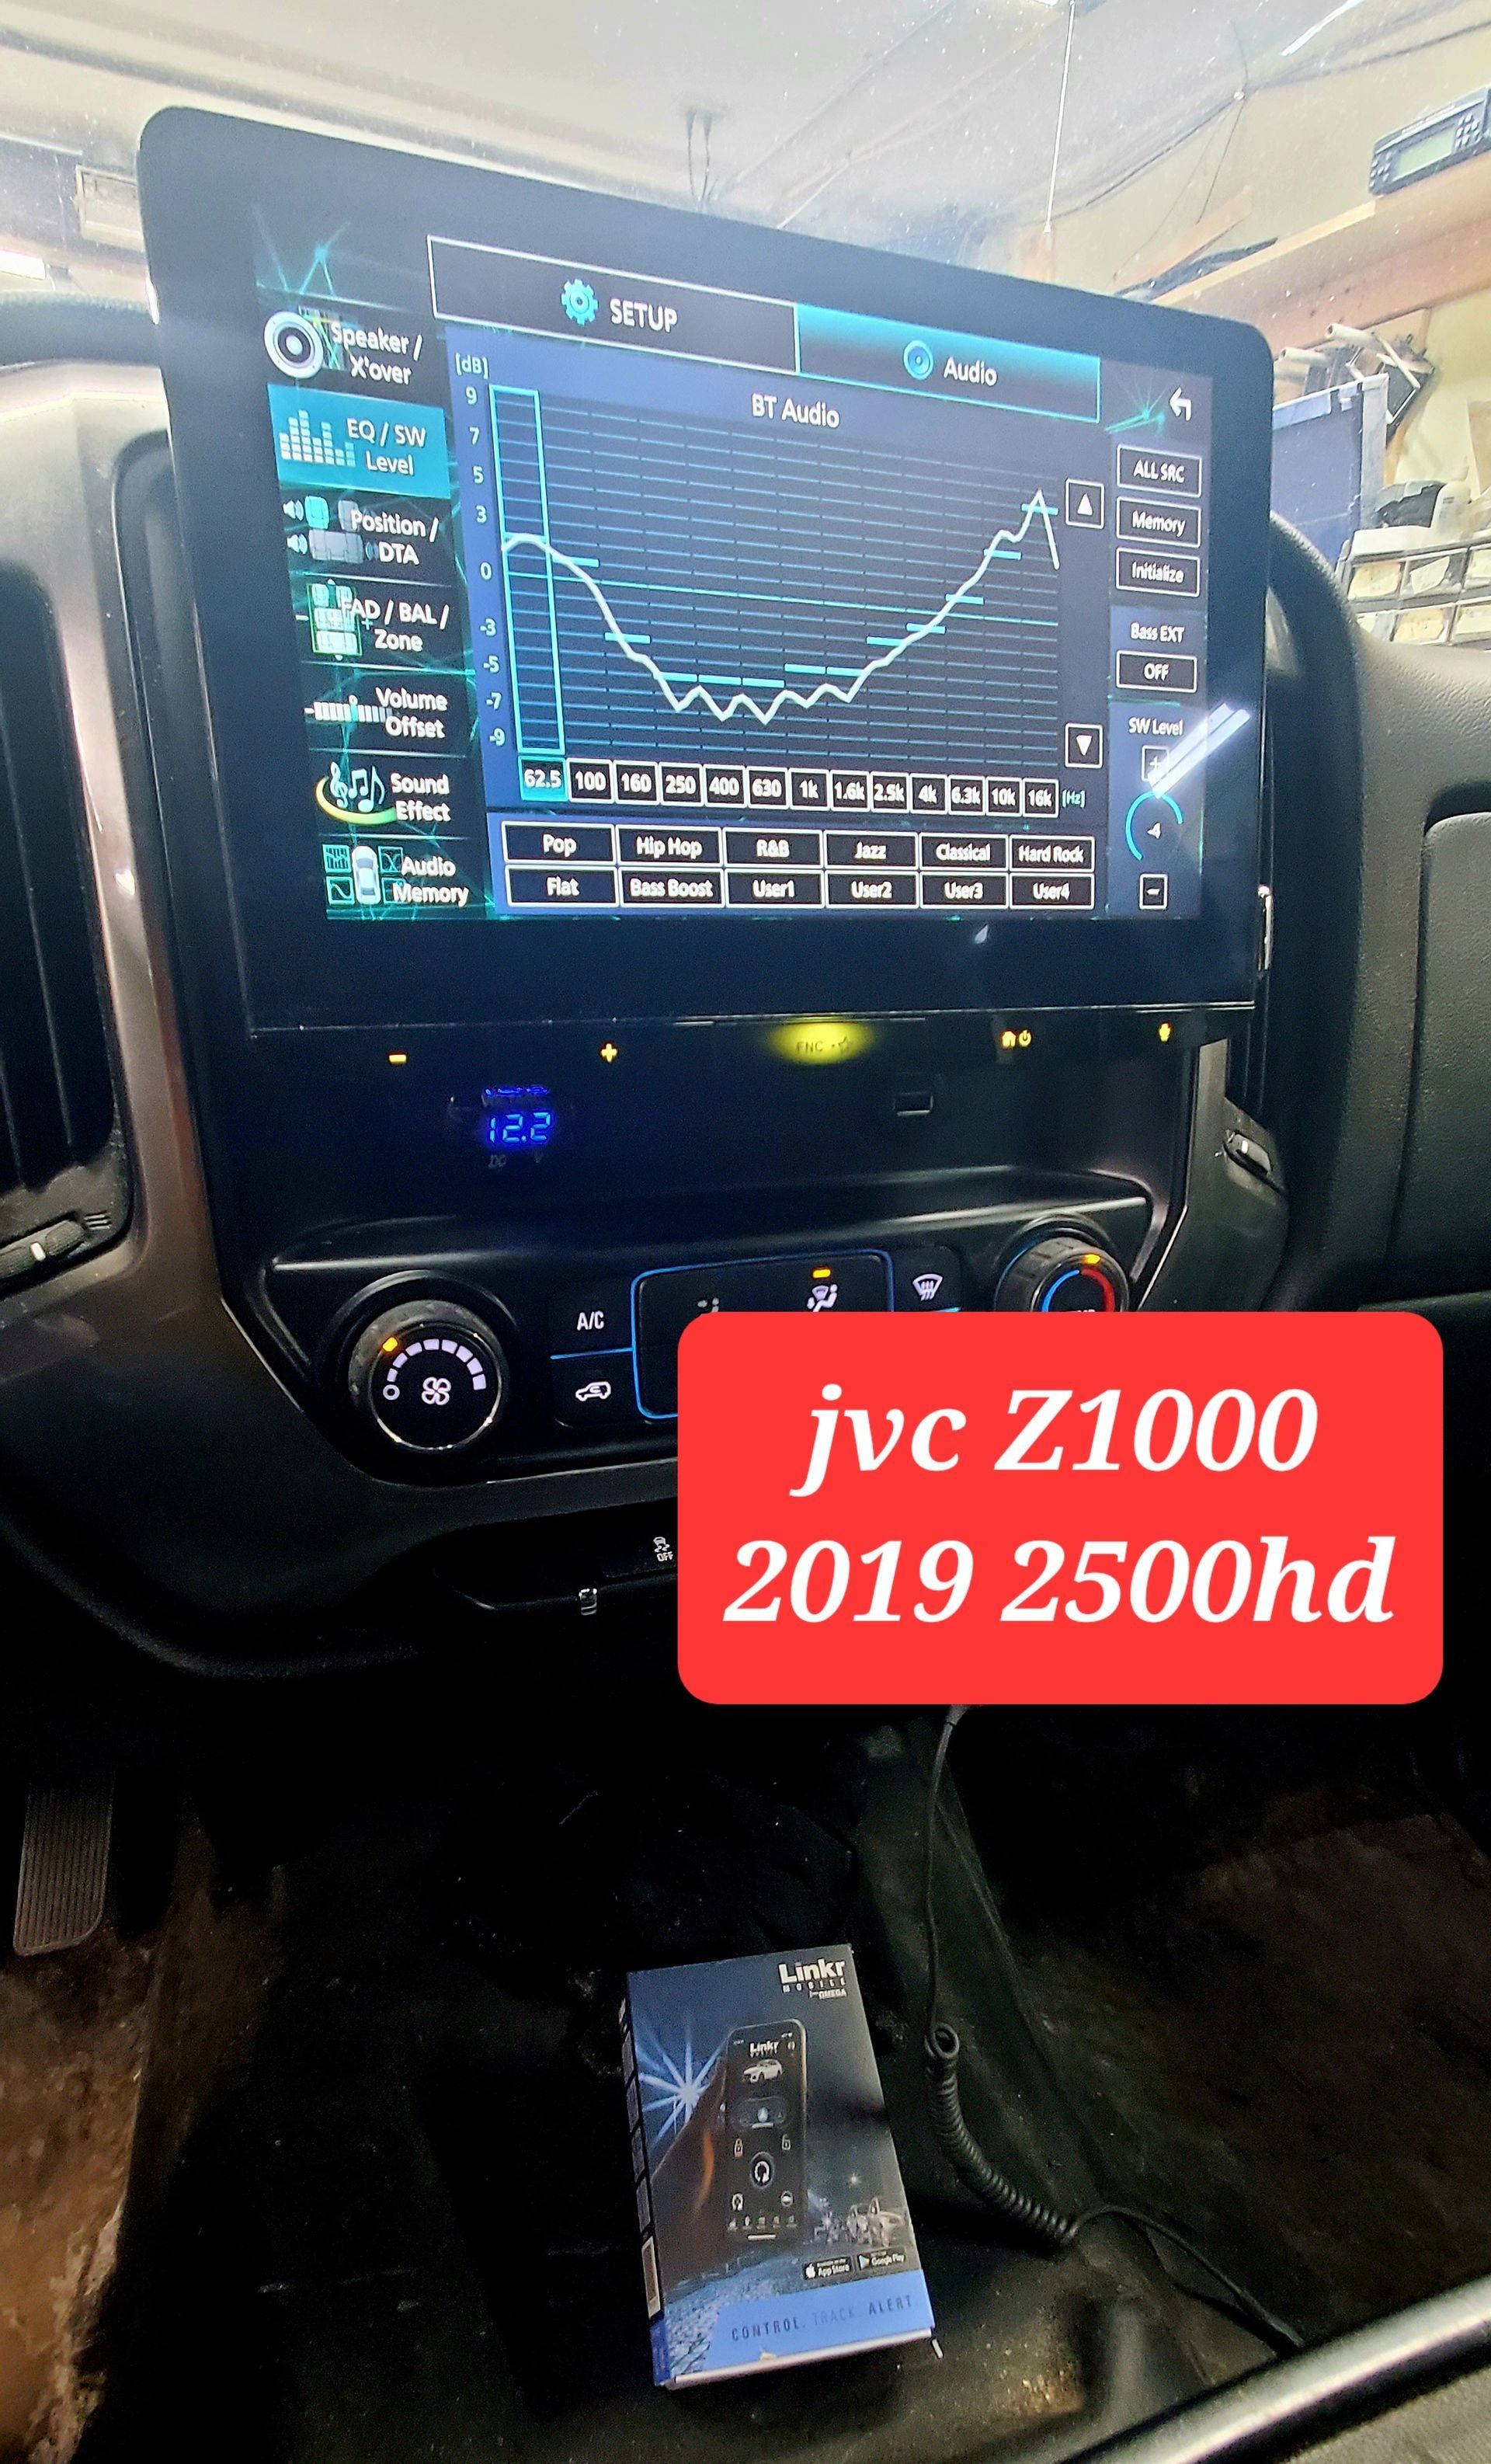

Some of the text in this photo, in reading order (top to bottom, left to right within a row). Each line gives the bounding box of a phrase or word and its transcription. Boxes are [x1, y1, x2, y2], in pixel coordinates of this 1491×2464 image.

[610, 298, 678, 332] SETUP
[332, 322, 409, 354] Speaker
[350, 354, 412, 385] X'over
[455, 353, 489, 379] [dB]
[943, 357, 998, 386] Audio
[465, 387, 478, 405] 9
[751, 393, 840, 428] BT Audio
[347, 418, 375, 442] EQ
[394, 426, 426, 447] SW
[469, 426, 480, 445] 7
[366, 451, 415, 475] Level
[1133, 459, 1185, 483] ALL SRC
[473, 466, 484, 484] 5
[350, 508, 426, 538] Position
[476, 505, 488, 524] 3
[1132, 510, 1186, 538] Memory
[378, 541, 419, 565] DTA
[480, 562, 492, 580] 0
[1131, 561, 1184, 584] Initialize
[341, 598, 381, 620] FAD
[398, 602, 437, 625] BAL
[480, 619, 496, 636] -3
[1131, 622, 1184, 643] Bass EXT
[374, 628, 423, 652] Zone
[483, 656, 499, 673] -5
[1143, 663, 1170, 681] OFF
[376, 687, 448, 712] Volume
[486, 692, 502, 710] -7
[385, 715, 446, 739] Offset
[489, 728, 506, 746] -9
[1128, 717, 1183, 736] SW Level
[391, 773, 450, 795] Sound
[523, 768, 562, 789] 62.5
[575, 771, 606, 792] 100
[621, 772, 652, 793] 160
[665, 774, 697, 794] 250
[708, 777, 739, 797] 400
[752, 778, 782, 798] 630
[798, 779, 818, 799] 1k
[834, 781, 865, 801] 1.6k
[874, 783, 905, 802] 2.5k
[918, 785, 937, 804] 4k
[951, 785, 981, 806] 6.3k
[991, 787, 1016, 807] 10k
[1027, 788, 1052, 809] 16k
[1062, 789, 1086, 809] [Hz]
[395, 800, 451, 822] Effect
[543, 834, 577, 858] Pop
[636, 835, 703, 859] Hip Hop
[756, 839, 790, 858] R&B
[855, 841, 887, 860] Jazz
[936, 842, 991, 861] Classical
[1018, 844, 1084, 864] Hard Rock
[401, 856, 456, 877] Audio
[392, 882, 469, 907] Memory
[547, 876, 580, 896] Flat
[630, 878, 714, 899] Bass Boost
[752, 879, 794, 898] User1
[851, 880, 892, 900] User2
[944, 881, 983, 900] User3
[1032, 882, 1069, 901] User4
[489, 1112, 551, 1143] 12.2
[576, 1311, 604, 1331] A/C
[657, 1551, 673, 1561] OFF
[778, 1958, 846, 1984] Linkr
